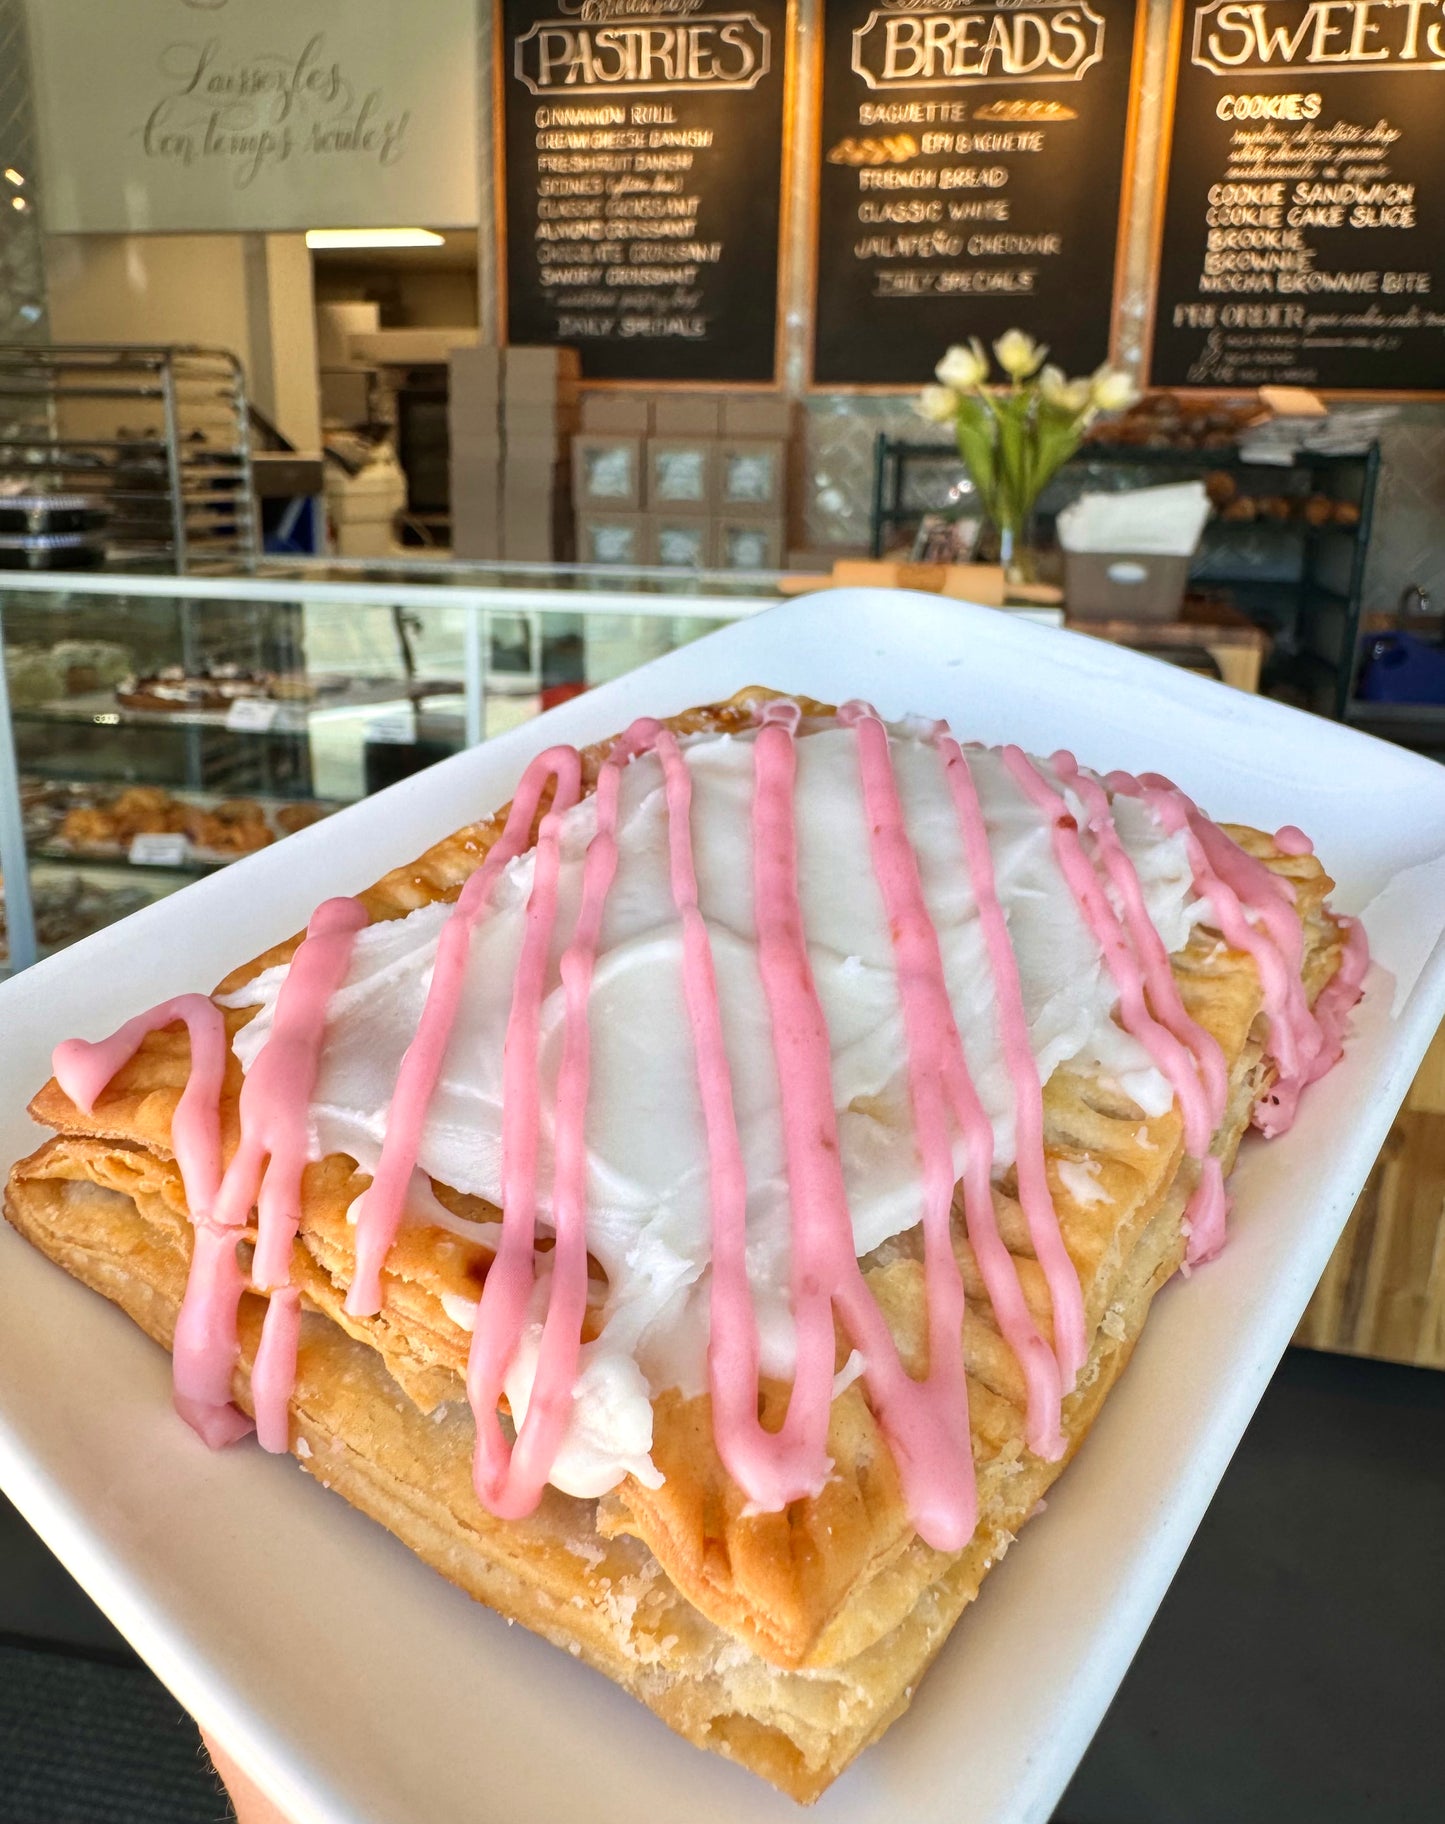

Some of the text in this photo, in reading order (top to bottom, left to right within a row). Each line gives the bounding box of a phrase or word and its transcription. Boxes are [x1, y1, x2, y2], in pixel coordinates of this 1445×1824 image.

[537, 23, 755, 85] PASTRIES
[882, 11, 1087, 78] BREADS
[535, 103, 678, 128] CINNAMON ROLL
[859, 102, 967, 125] BAGUETTE
[1216, 92, 1322, 121] COOKIES
[649, 127, 714, 148] DANISH
[955, 131, 1045, 153] BAGUETTE
[859, 166, 1009, 190] FRENCH BREAD
[1207, 183, 1416, 206] COOKIE SANDWICH
[858, 201, 1010, 223] CLASSIC WHITE
[1206, 205, 1416, 228] COOKIE CAKE SLICE
[967, 233, 1062, 256] CHEDDAR
[1207, 228, 1306, 250] BROOKIE
[1204, 250, 1318, 275] BROWNIE
[934, 271, 1034, 292] SPECIALS
[1199, 271, 1432, 294] MOCHA BROWNIE BITE
[617, 315, 706, 337] SPECIALS
